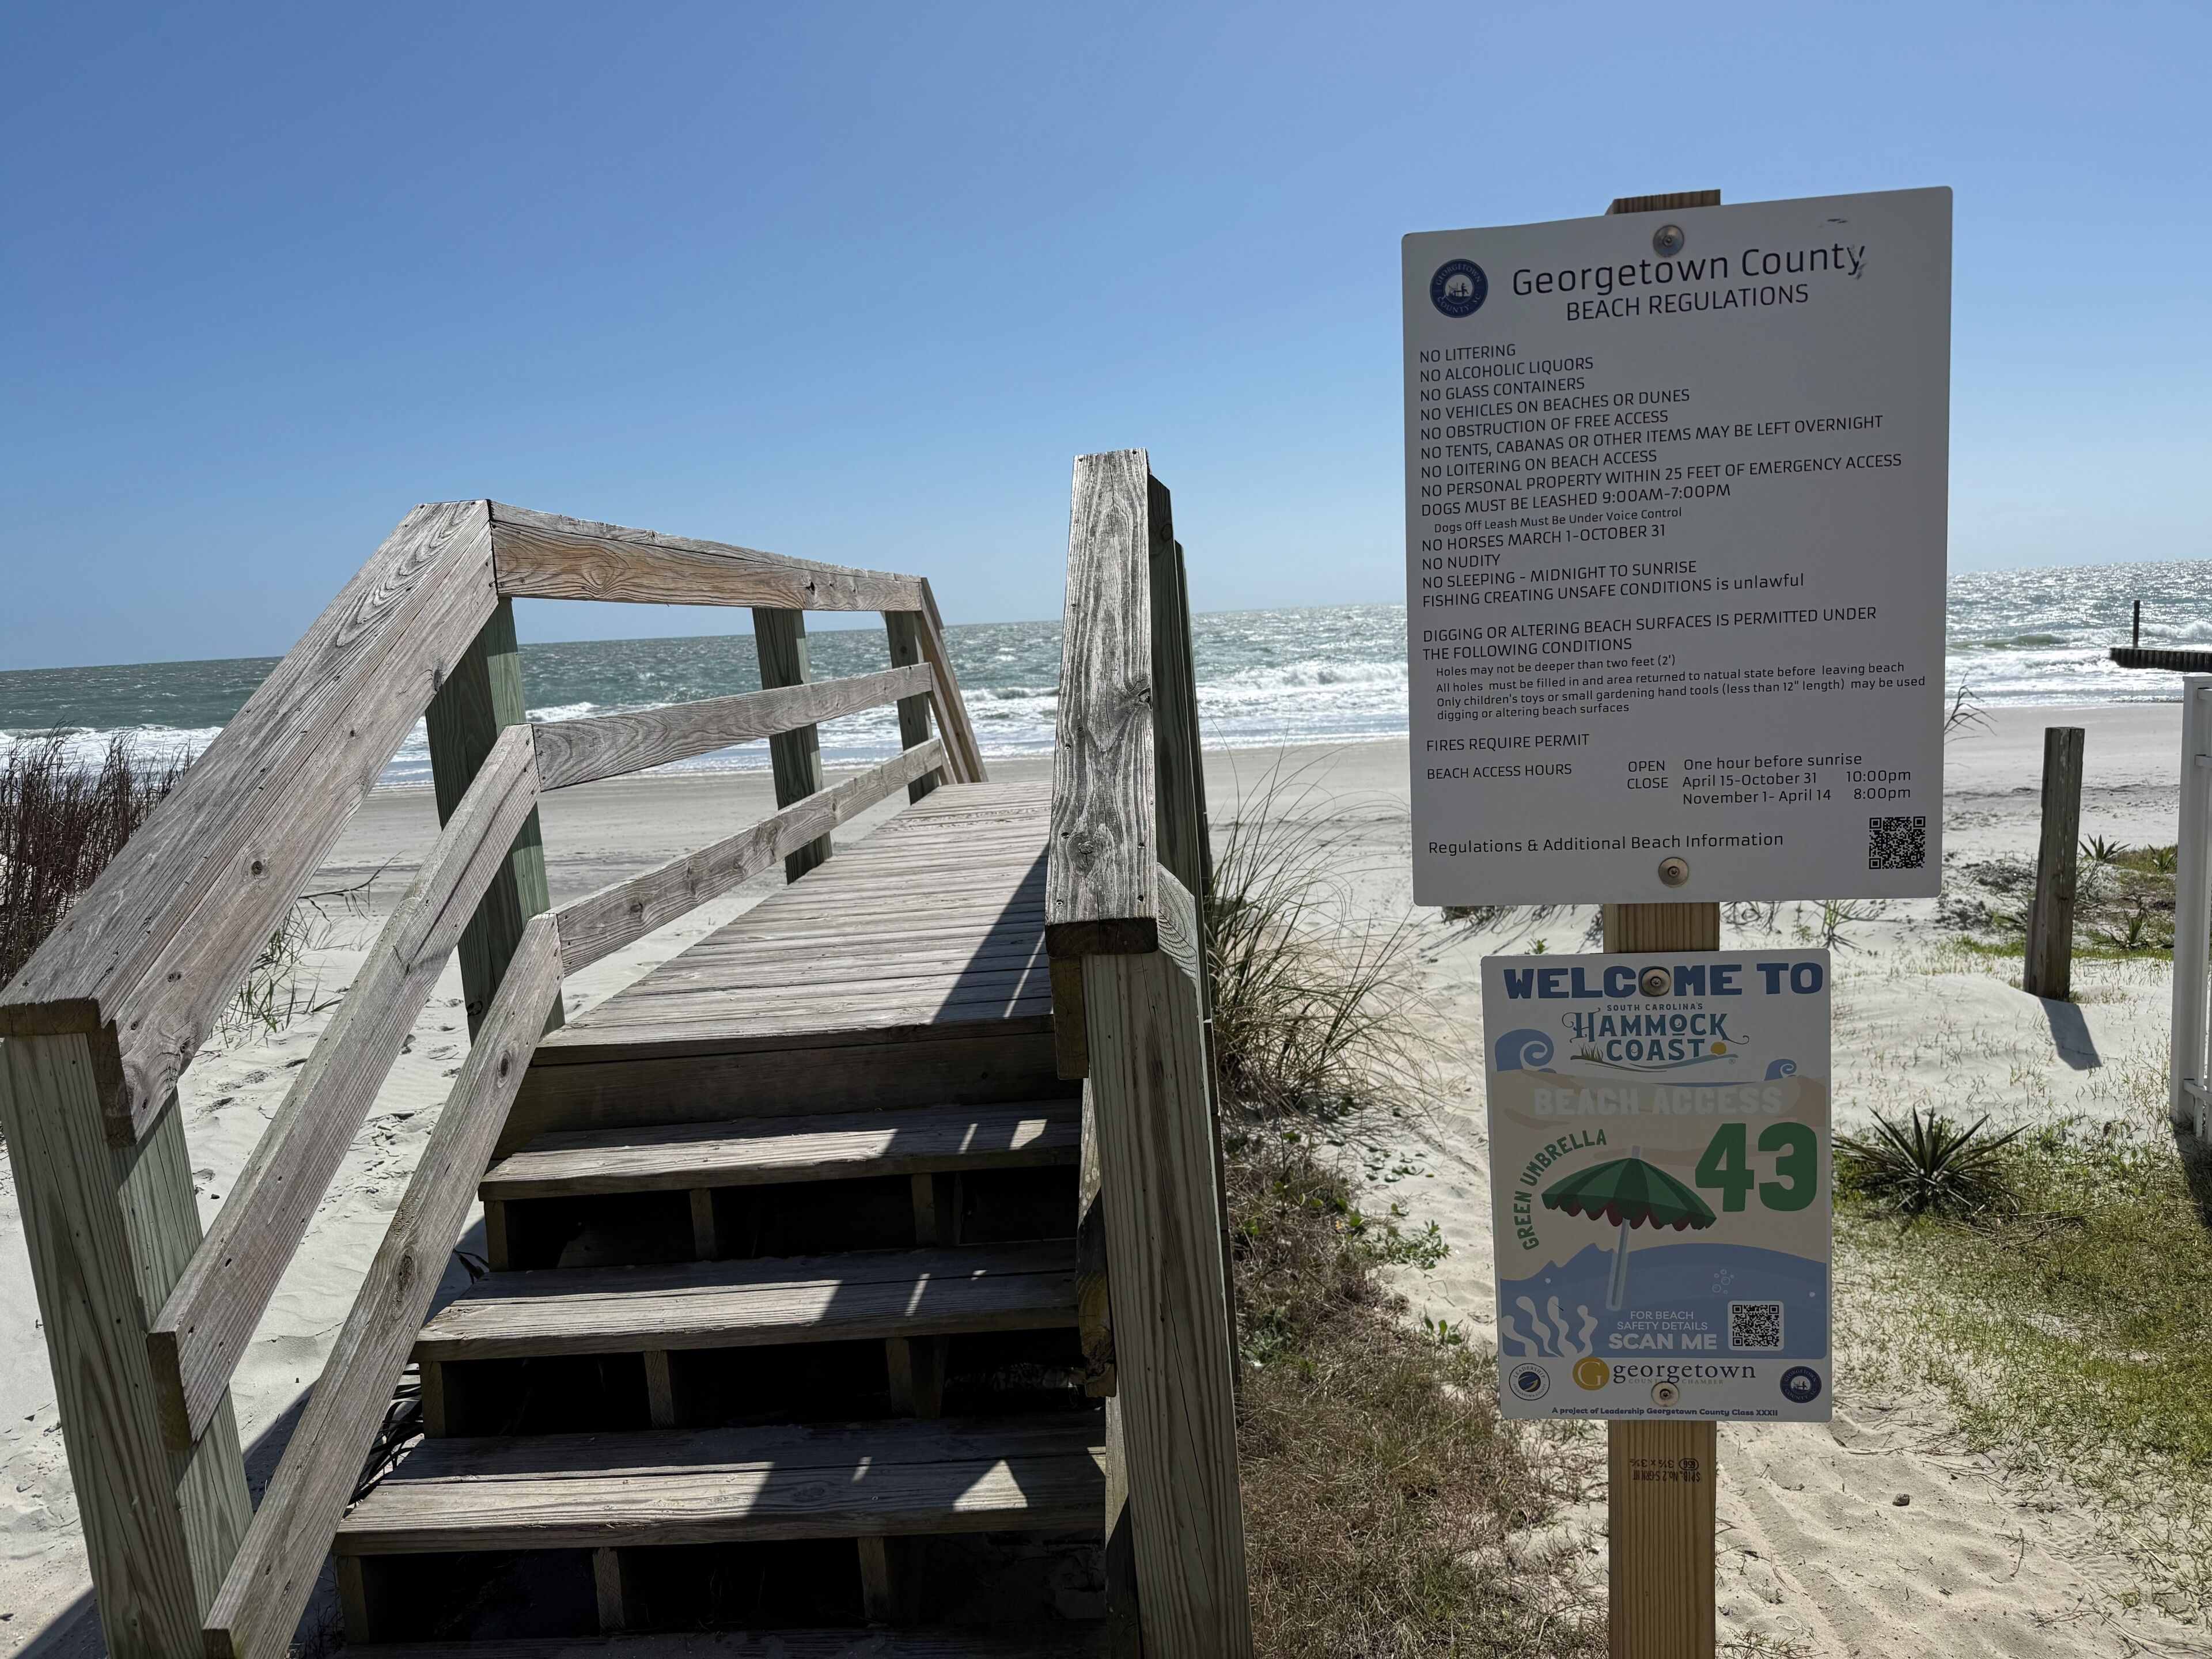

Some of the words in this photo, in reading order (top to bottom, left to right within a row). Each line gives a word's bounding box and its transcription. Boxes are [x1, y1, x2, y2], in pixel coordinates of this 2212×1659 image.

[1435, 263, 1482, 285] GEORGETOWN
[1514, 256, 1727, 296] Georgetown
[1742, 243, 1865, 277] County
[1567, 297, 1639, 320] BEACH
[1650, 283, 1808, 315] REGULATIONS
[1421, 350, 1440, 363] NO
[1446, 344, 1515, 361] LITTERING
[1422, 446, 1441, 460] NO
[1445, 443, 1491, 457] TENTS,
[1497, 437, 1563, 453] CABANAS
[1569, 435, 1589, 448] OR
[1594, 431, 1642, 446] OTHER
[1647, 428, 1691, 442] ITEMS
[1696, 425, 1729, 440] MAY
[1735, 424, 1752, 437] BE
[1758, 422, 1790, 435] LEFT
[1795, 415, 1883, 433] OVERNIGHT
[1422, 485, 1441, 498] NO
[1447, 479, 1522, 495] PERSONAL
[1527, 472, 1601, 490] PROPERTY
[1606, 469, 1660, 484] WITHIN
[1665, 468, 1681, 480] 25
[1688, 465, 1721, 479] FEET
[1726, 463, 1744, 476] OF
[1750, 457, 1842, 475] EMERGENCY
[1846, 454, 1901, 469] ACCESS
[1434, 524, 1462, 534] Dogs
[1465, 520, 1482, 531] Off
[1485, 518, 1516, 529] Leash
[1521, 517, 1549, 527] Must
[1552, 516, 1566, 524] Be
[1569, 513, 1604, 523] Under
[1606, 510, 1637, 521] Voice
[1642, 507, 1681, 518] Control
[1423, 558, 1442, 570] NO
[1448, 554, 1500, 569] NUDITY
[1424, 628, 1482, 642] DIGGING
[1487, 626, 1506, 638] OR
[1510, 622, 1580, 637] ALTERING
[1585, 619, 1631, 632] BEACH
[1636, 615, 1711, 630] SURFACES
[1717, 614, 1729, 626] IS
[1734, 609, 1817, 625] PERMITTED
[1824, 607, 1876, 621] UNDER
[1437, 666, 1467, 676] Holes
[1471, 667, 1493, 676] may
[1497, 665, 1515, 673] not
[1518, 662, 1531, 672] be
[1535, 662, 1575, 673] deeper
[1578, 660, 1603, 669] than
[1631, 657, 1654, 666] feet
[1658, 654, 1675, 666] (2')
[1437, 683, 1449, 692] All
[1453, 682, 1483, 692] holes
[1490, 681, 1517, 690] must
[1520, 679, 1533, 688] be
[1537, 677, 1565, 688] filled
[1569, 676, 1578, 686] in
[1583, 675, 1603, 685] and
[1607, 676, 1633, 684] area
[1636, 672, 1685, 683] returned
[1704, 669, 1740, 680] natual
[1744, 669, 1773, 678] state
[1778, 666, 1815, 676] before
[1823, 665, 1864, 675] leaving
[1869, 662, 1903, 673] beach
[1438, 697, 1461, 708] Only
[1464, 694, 1517, 705] children's
[1521, 695, 1544, 704] toys
[1562, 690, 1592, 700] small
[1597, 688, 1654, 702] gardening
[1658, 685, 1686, 696] hand
[1690, 684, 1719, 695] tools
[1722, 683, 1750, 695] (less
[1753, 682, 1779, 692] than
[1783, 680, 1798, 691] 12"
[1803, 679, 1844, 692] length)
[1851, 680, 1876, 690] may
[1879, 677, 1893, 687] be
[1897, 676, 1925, 687] used
[1438, 710, 1478, 721] digging
[1496, 706, 1539, 718] altering
[1543, 704, 1576, 715] beach
[1581, 703, 1629, 713] surfaces
[1427, 739, 1464, 751] FIRES
[1469, 736, 1531, 751] REQUIRE
[1536, 734, 1590, 747] PERMIT
[1427, 767, 1468, 779] BEACH
[1474, 766, 1521, 778] ACCESS
[1525, 764, 1571, 775] HOURS
[1628, 760, 1665, 772] OPEN
[1684, 759, 1712, 770] One
[1717, 757, 1750, 769] hour
[1755, 755, 1802, 767] before
[1808, 753, 1862, 766] sunrise
[1628, 778, 1668, 789] CLOSE
[1683, 774, 1715, 790] April
[1720, 772, 1800, 786] 15-October
[1804, 772, 1816, 783] 31
[1847, 770, 1910, 783] 10:00pm
[1683, 791, 1758, 804] November
[1779, 789, 1811, 804] April
[1817, 789, 1831, 801] 14
[1854, 788, 1910, 801] 8:00pm
[1430, 840, 1522, 856] Regulations
[1528, 840, 1538, 851] &
[1543, 836, 1624, 850] Additional
[1632, 835, 1680, 849] Beach
[1687, 832, 1782, 847] Information
[1756, 963, 1823, 995] TO
[1645, 1002, 1703, 1010] CAROLINA'S
[1568, 1009, 1738, 1043] HAMMOCK
[1606, 1039, 1705, 1061] COAST
[1534, 1088, 1641, 1115] BEACH
[1652, 1087, 1783, 1115] ACCESS
[1520, 1129, 1607, 1187] UMBRELLA
[1695, 1122, 1817, 1212] 43
[1513, 1191, 1539, 1250] GREEN
[1630, 1310, 1653, 1320] FOR
[1656, 1311, 1694, 1320] BEACH
[1617, 1321, 1658, 1330] SAFETY
[1662, 1321, 1708, 1331] DETAILS
[1608, 1333, 1673, 1350] SCAN
[1681, 1334, 1717, 1350] ME
[1513, 1366, 1546, 1378] LEADERSHIP
[1613, 1363, 1756, 1384] georgetown
